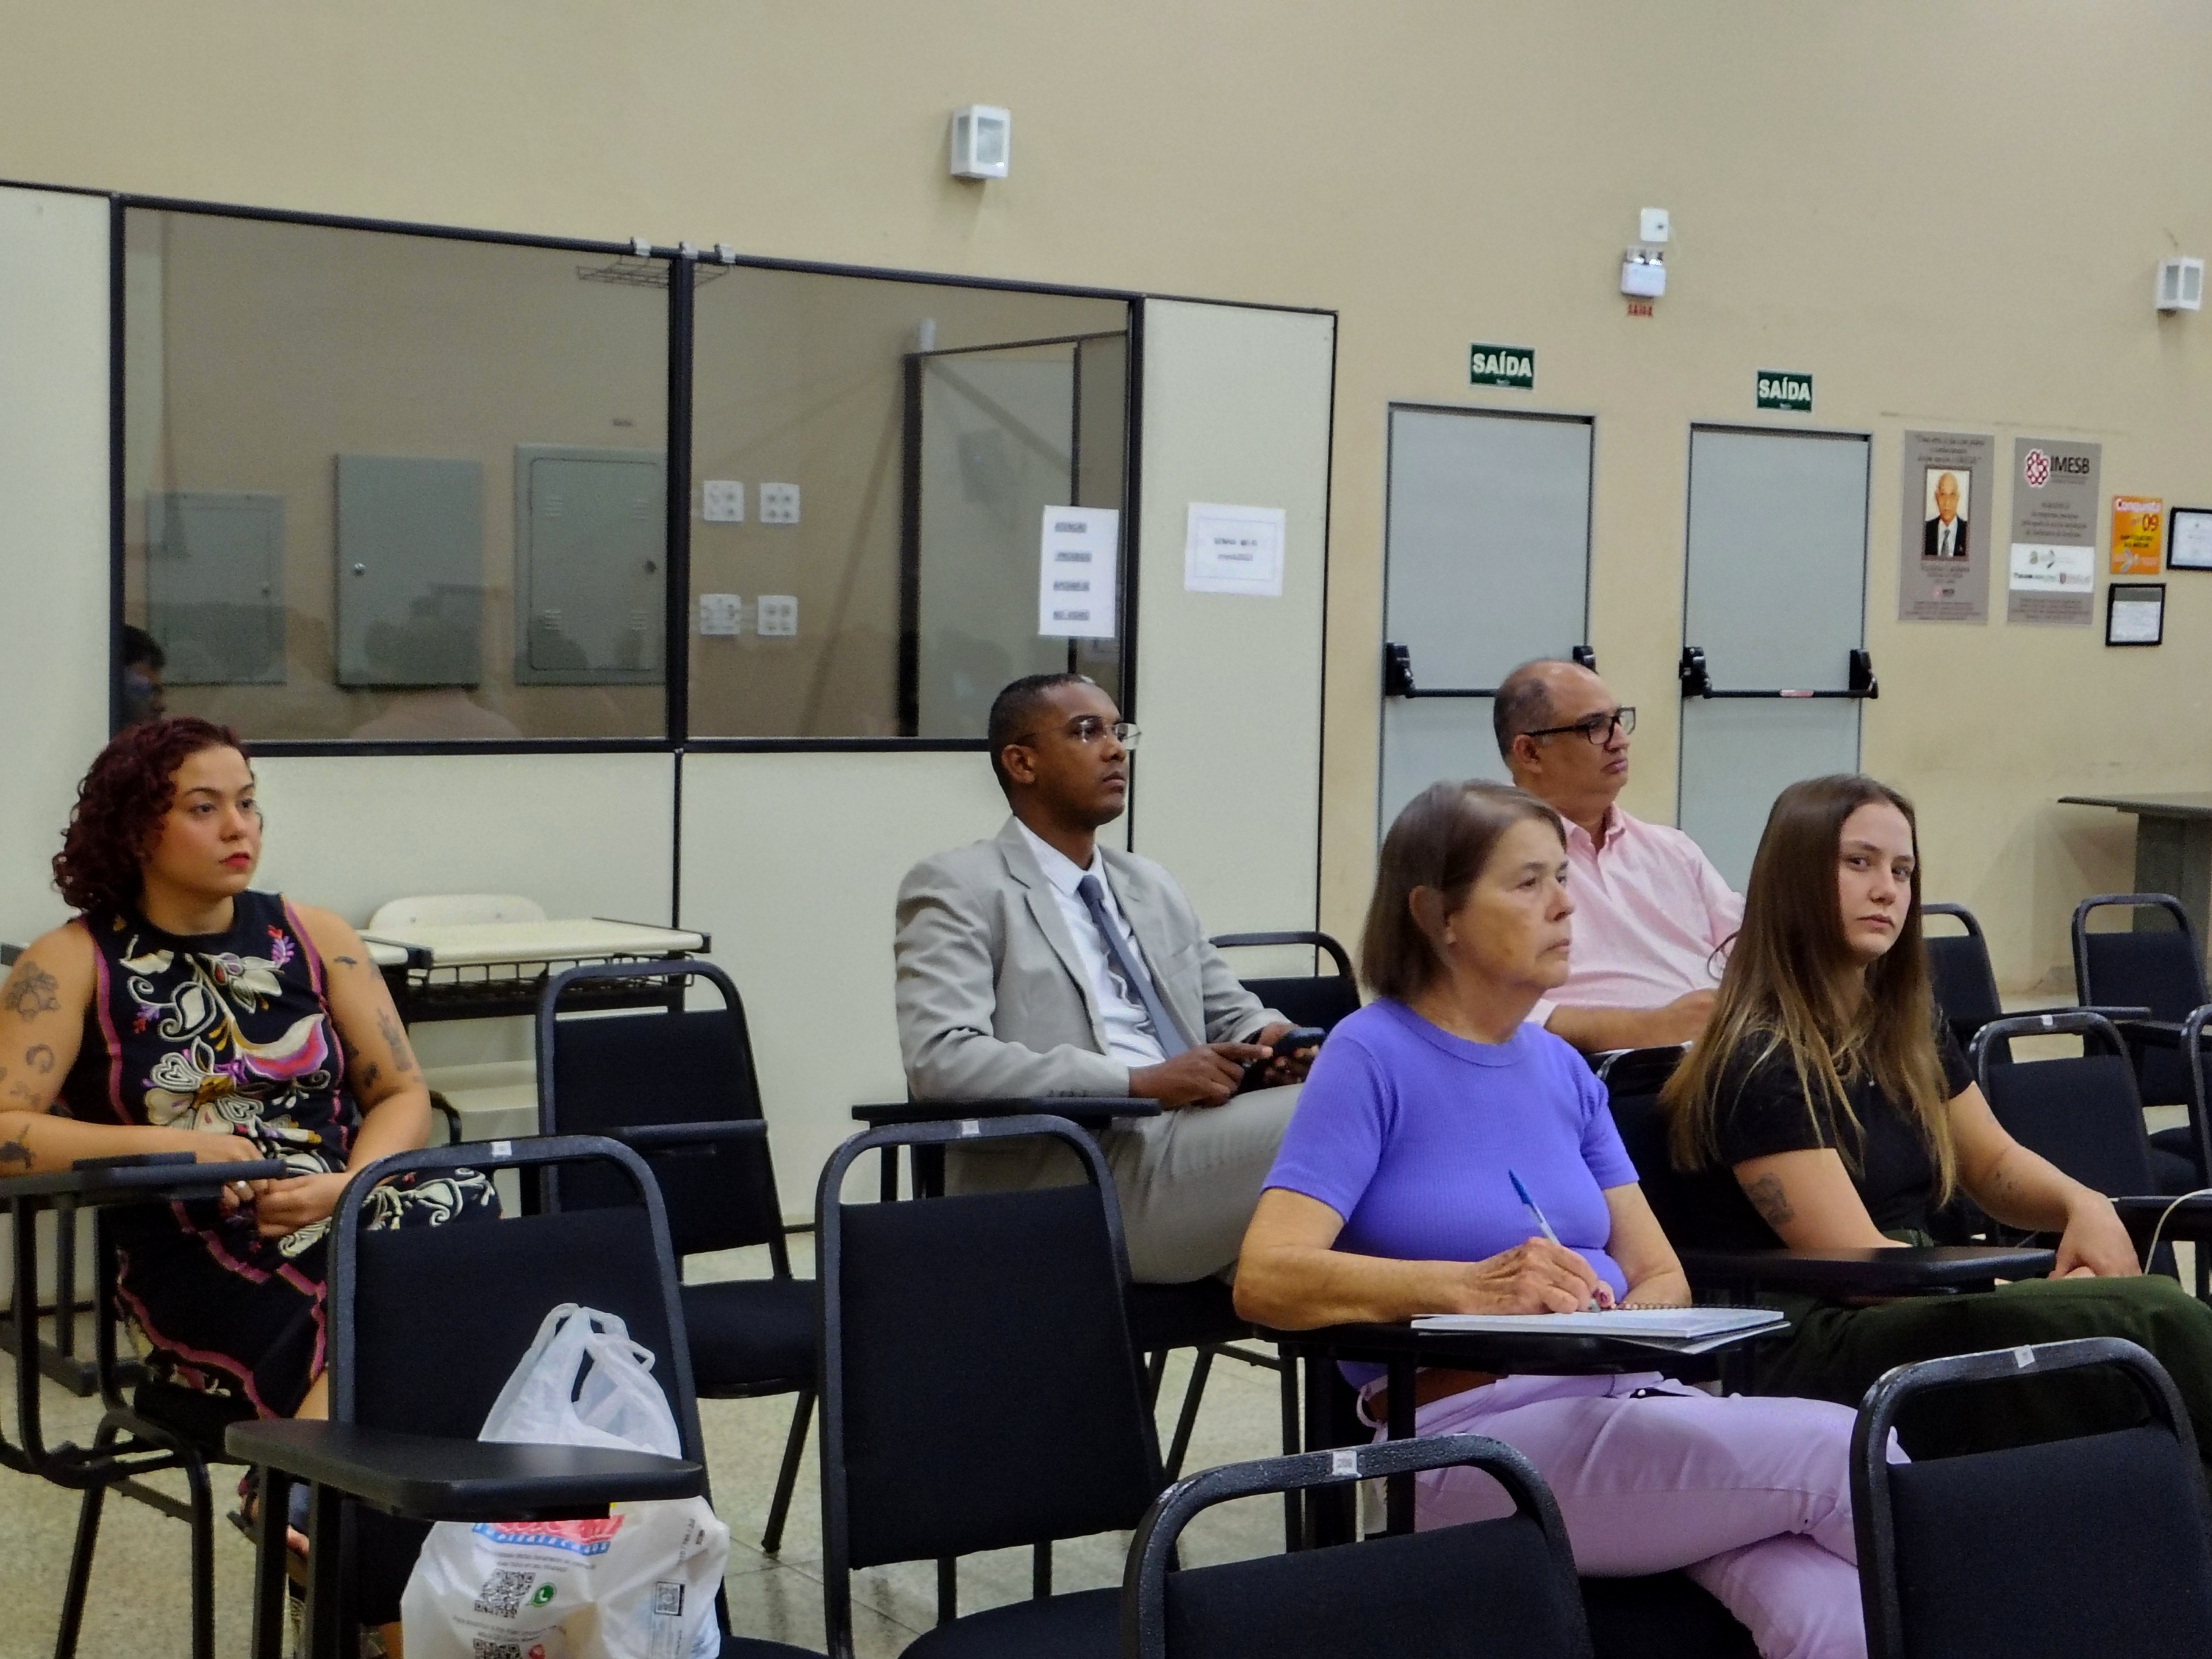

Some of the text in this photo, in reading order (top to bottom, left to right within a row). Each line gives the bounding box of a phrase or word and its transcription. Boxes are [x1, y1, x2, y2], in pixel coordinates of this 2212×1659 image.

[1473, 350, 1532, 377] SAÍDA
[1759, 376, 1811, 401] SAÍDA
[2051, 456, 2090, 474] IMESB
[2142, 513, 2159, 531] 09
